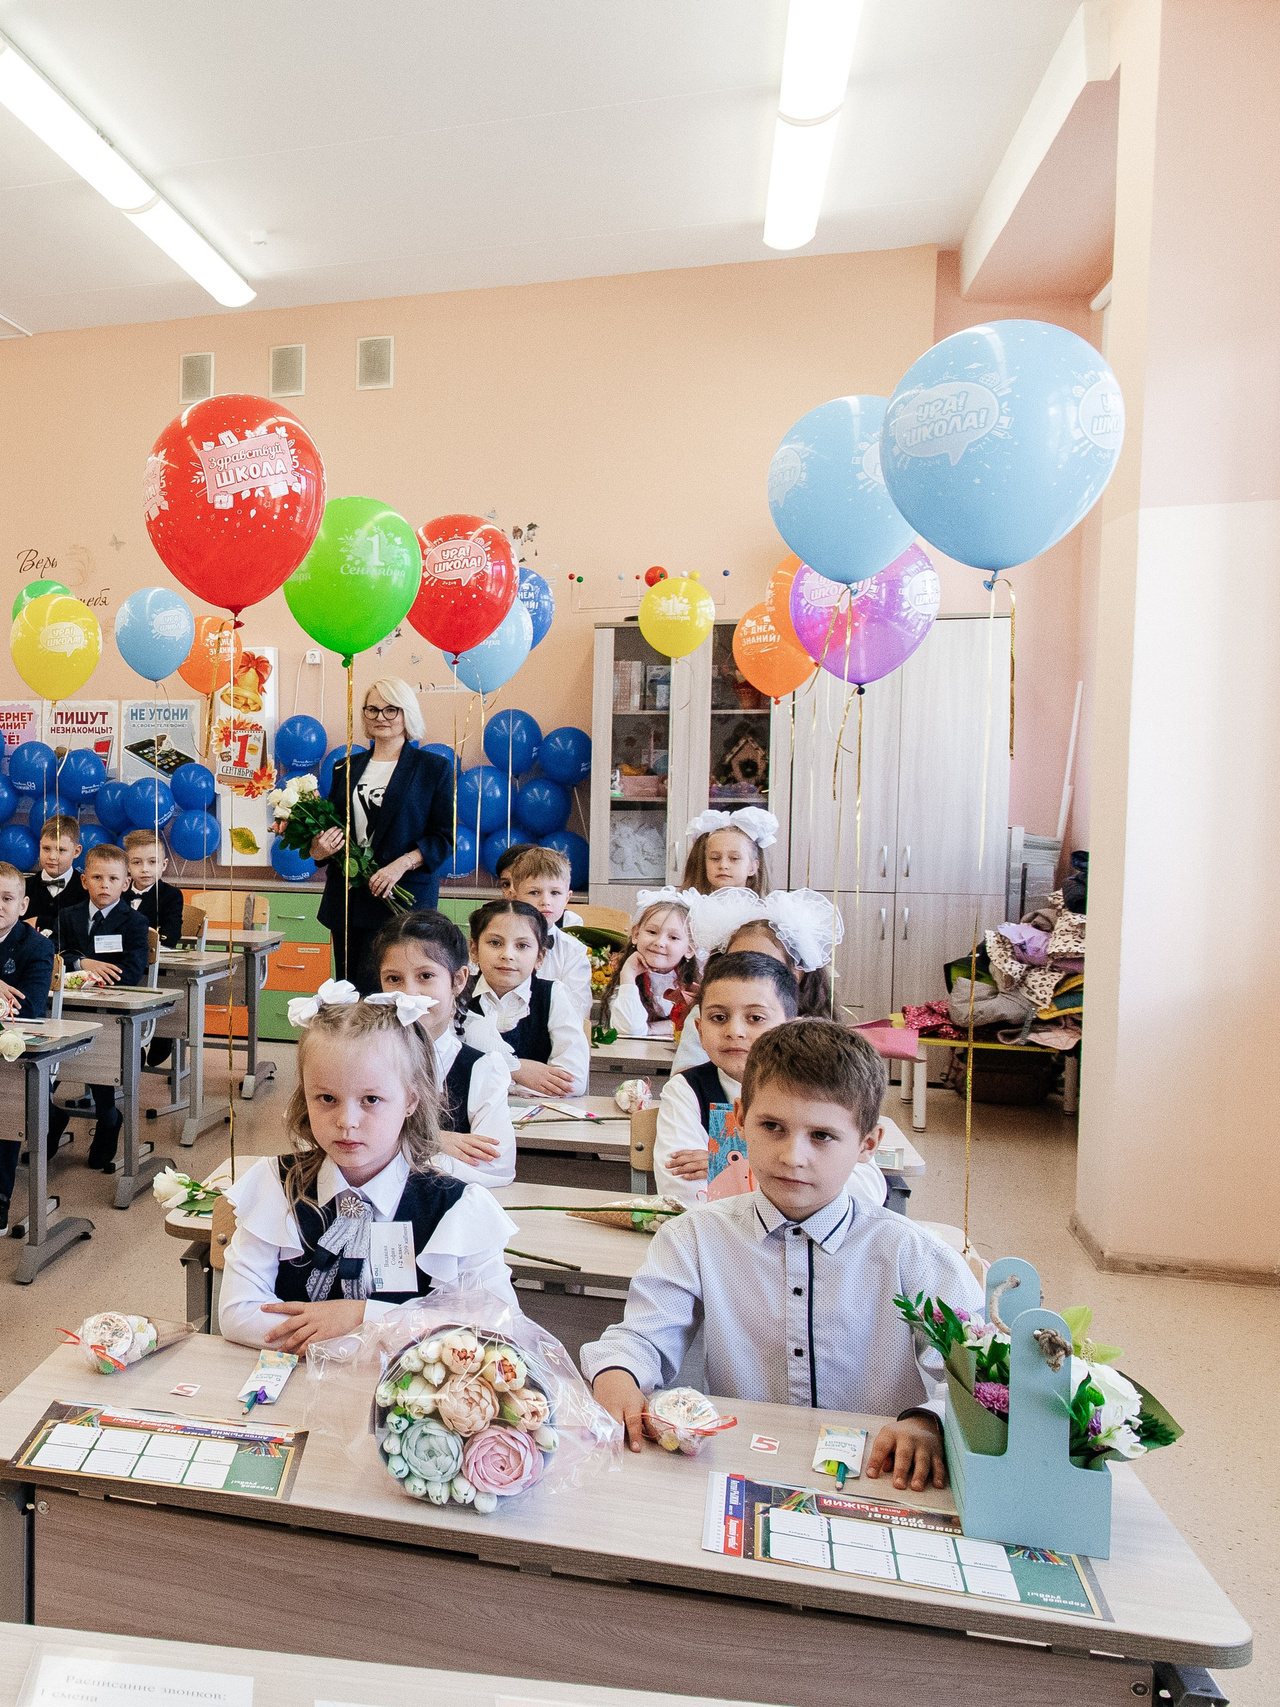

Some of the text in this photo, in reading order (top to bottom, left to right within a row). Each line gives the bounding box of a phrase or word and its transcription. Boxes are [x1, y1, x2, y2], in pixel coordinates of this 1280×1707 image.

[916, 391, 969, 422] УРА!
[903, 407, 988, 448] ШКОЛА!
[208, 441, 286, 471] Здравствуй,
[215, 458, 288, 489] ШКОЛА
[366, 533, 385, 567] 1
[441, 546, 471, 561] УРА!
[16, 548, 58, 579] Верь
[434, 554, 483, 574] ШКОЛА!
[339, 563, 406, 580] Сентября
[52, 628, 74, 637] УРА!
[741, 633, 782, 647] ЗНАНИЙ!
[47, 636, 82, 648] ШКОЛА!
[54, 711, 109, 725] ПИШУТ
[130, 708, 189, 721] НЕ УТОНИ
[50, 726, 113, 734] НЕЗНАКОМЦЫ?
[233, 734, 250, 768] 1
[221, 765, 254, 777] СЕНТЯБРЯ
[751, 1436, 778, 1451] 5
[822, 1498, 879, 1512] РЫЖИЙ
[891, 1519, 962, 1534] списание
[1042, 1596, 1087, 1608] Хорошей
[65, 1674, 227, 1701] Расписание звонков:
[51, 1690, 99, 1704] смена
